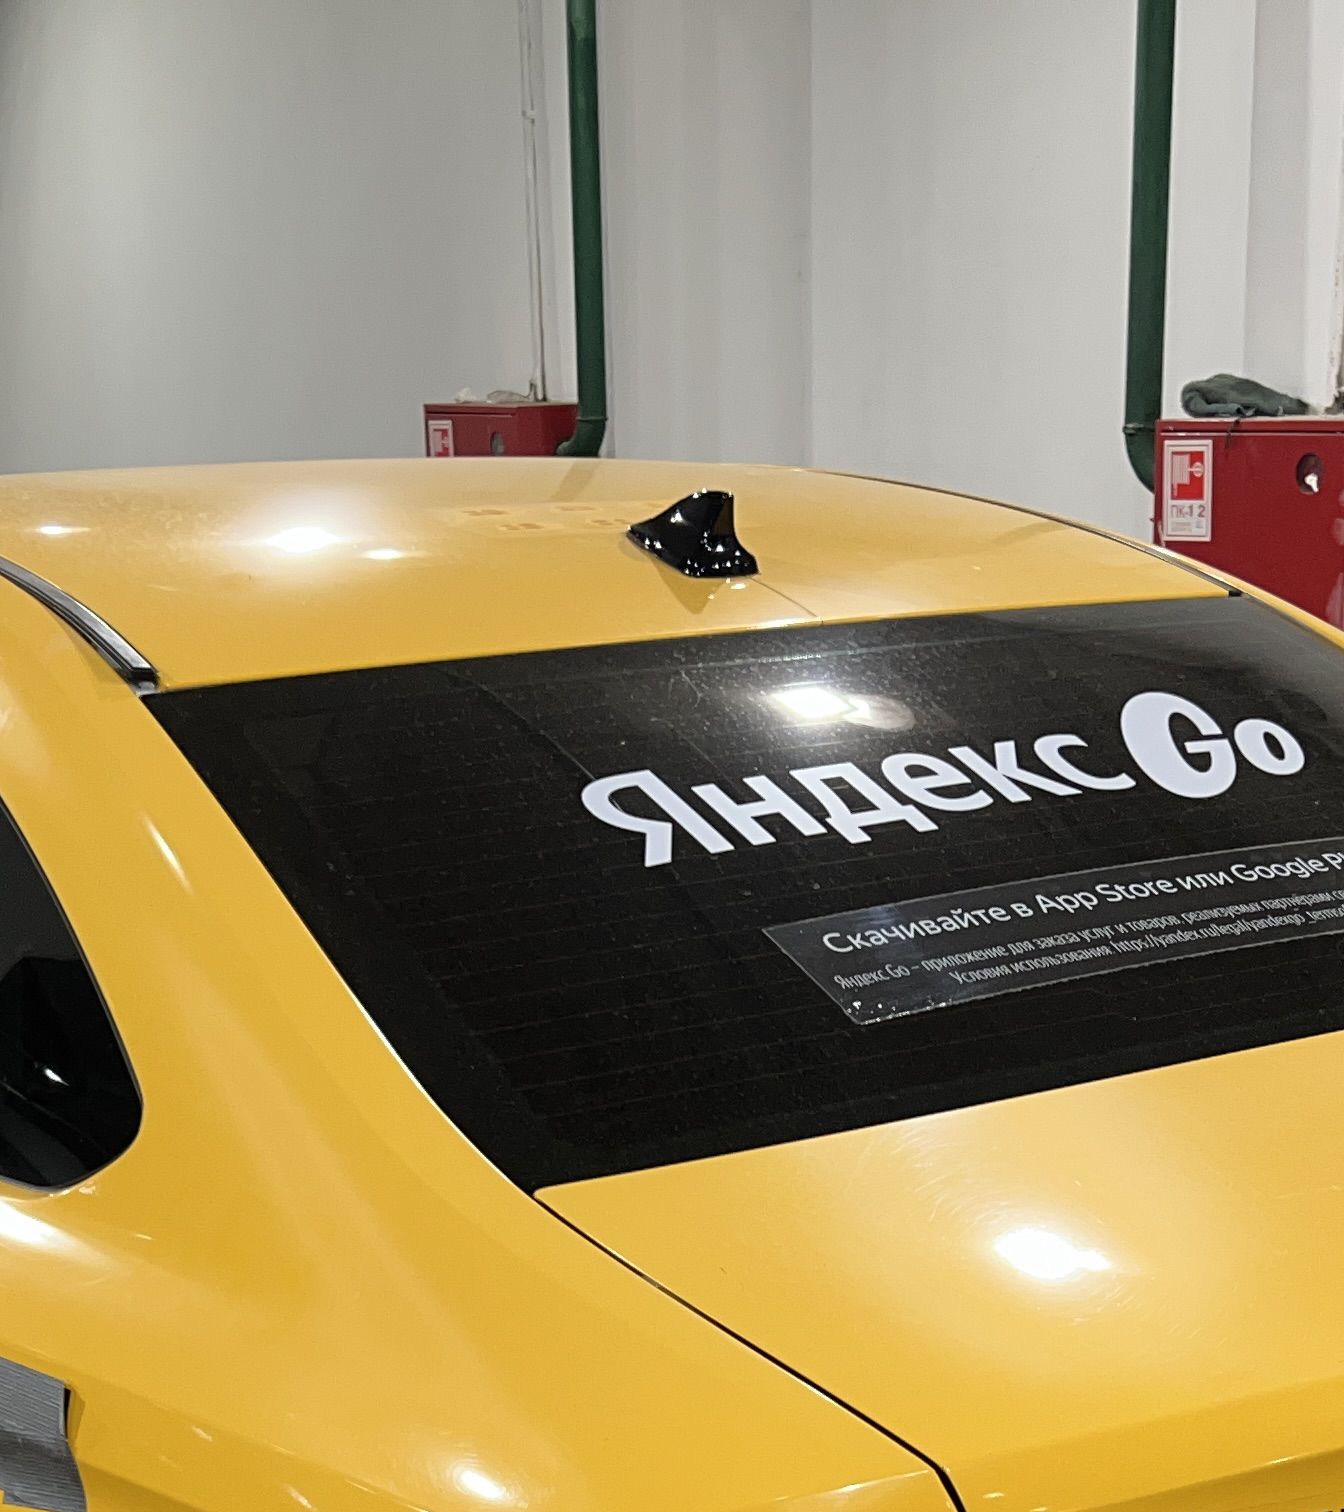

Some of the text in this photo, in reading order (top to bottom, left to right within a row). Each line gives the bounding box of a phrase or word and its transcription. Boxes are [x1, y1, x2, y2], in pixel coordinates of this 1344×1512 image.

[581, 691, 1306, 868] Яндекс Go
[821, 908, 1011, 953] Скачивайте
[1010, 901, 1034, 918] в
[1032, 889, 1099, 914] App
[1099, 876, 1178, 904] Store
[1175, 869, 1234, 891] или
[1231, 857, 1329, 882] Google
[833, 969, 890, 990] Яндекс
[884, 963, 911, 979] Go
[920, 945, 1010, 972] приложение
[1007, 940, 1036, 956] для
[1032, 932, 1081, 949] заказа
[1077, 925, 1115, 943] услуг
[1114, 924, 1129, 934] и
[1181, 901, 1265, 926] реализуемых
[948, 964, 1012, 985] Условия
